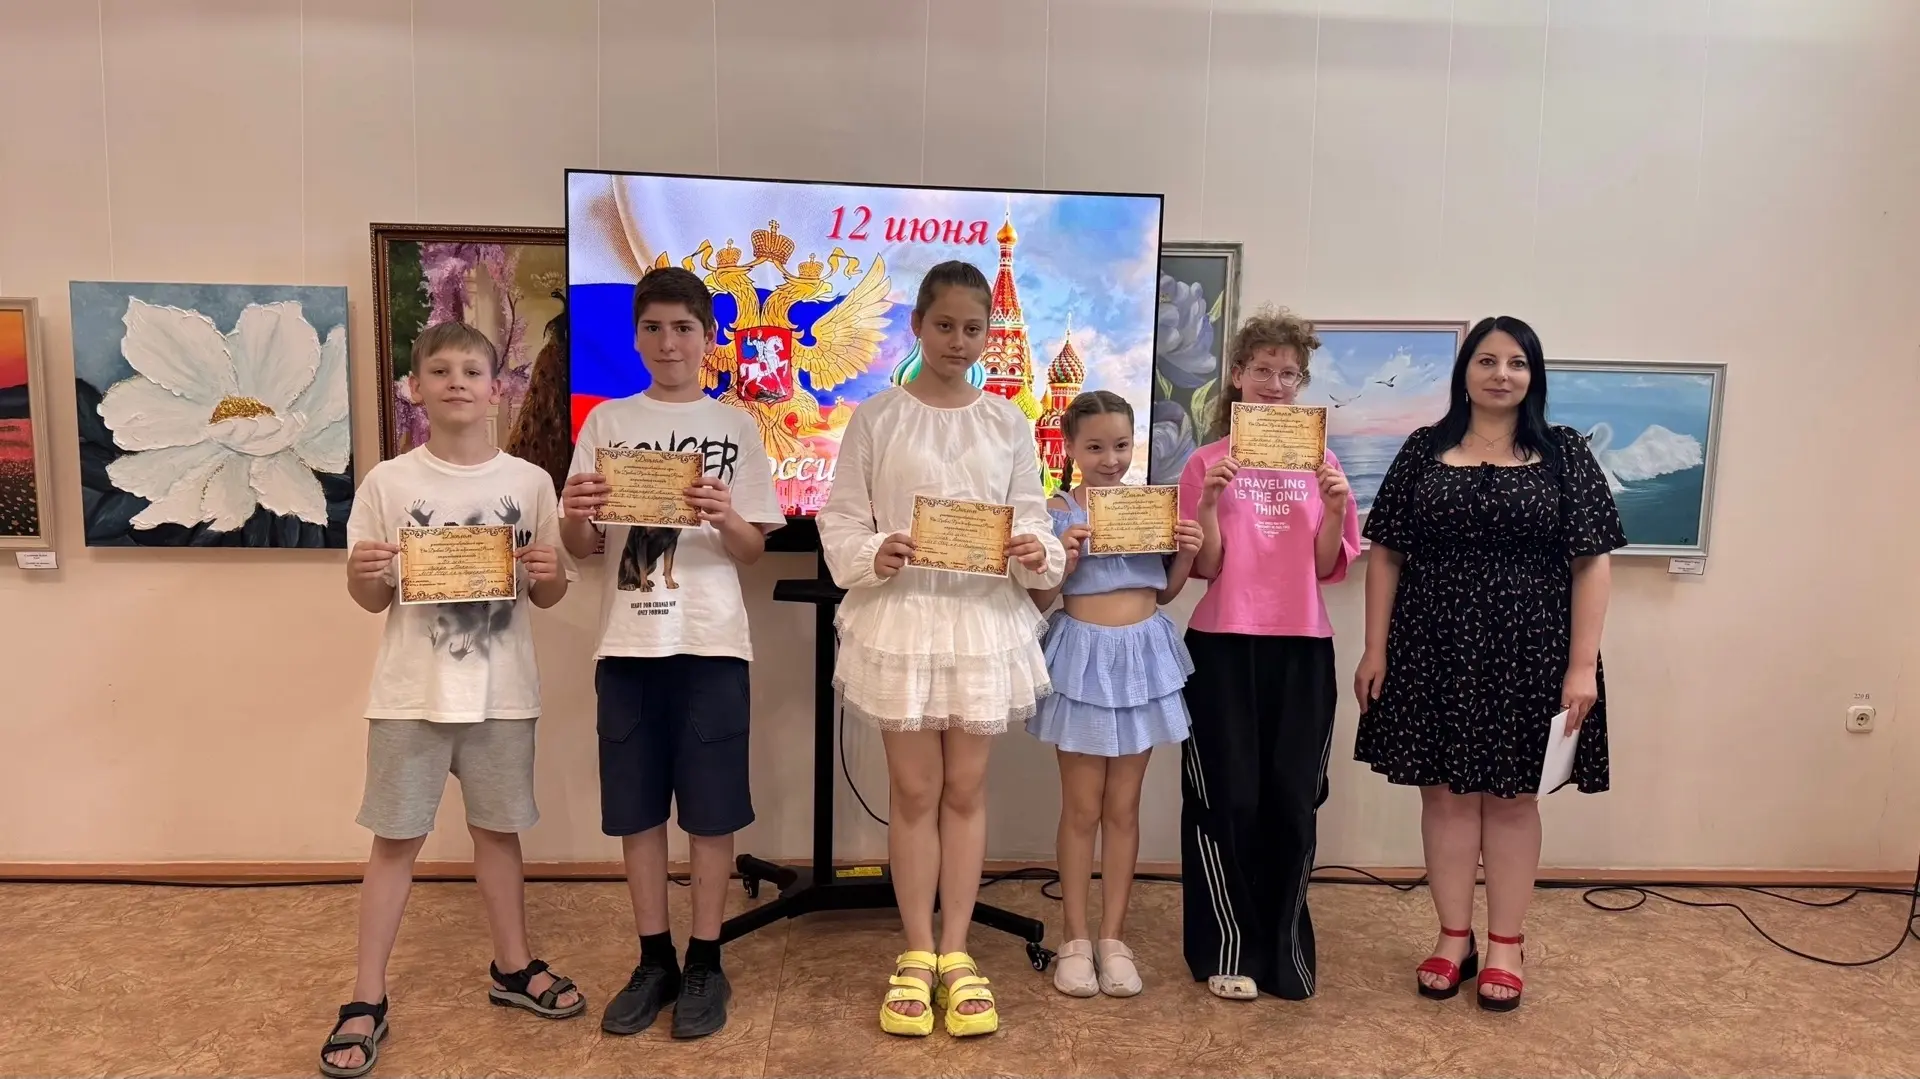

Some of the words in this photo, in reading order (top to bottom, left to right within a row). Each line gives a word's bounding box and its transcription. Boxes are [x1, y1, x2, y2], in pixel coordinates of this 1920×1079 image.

[826, 204, 872, 242] 12
[884, 216, 989, 246] июня
[768, 456, 837, 482] осси
[1235, 477, 1306, 490] TRAVELING
[1234, 489, 1246, 500] IS
[1249, 489, 1272, 503] THE
[1275, 490, 1309, 502] ONLY
[1254, 502, 1290, 516] THING
